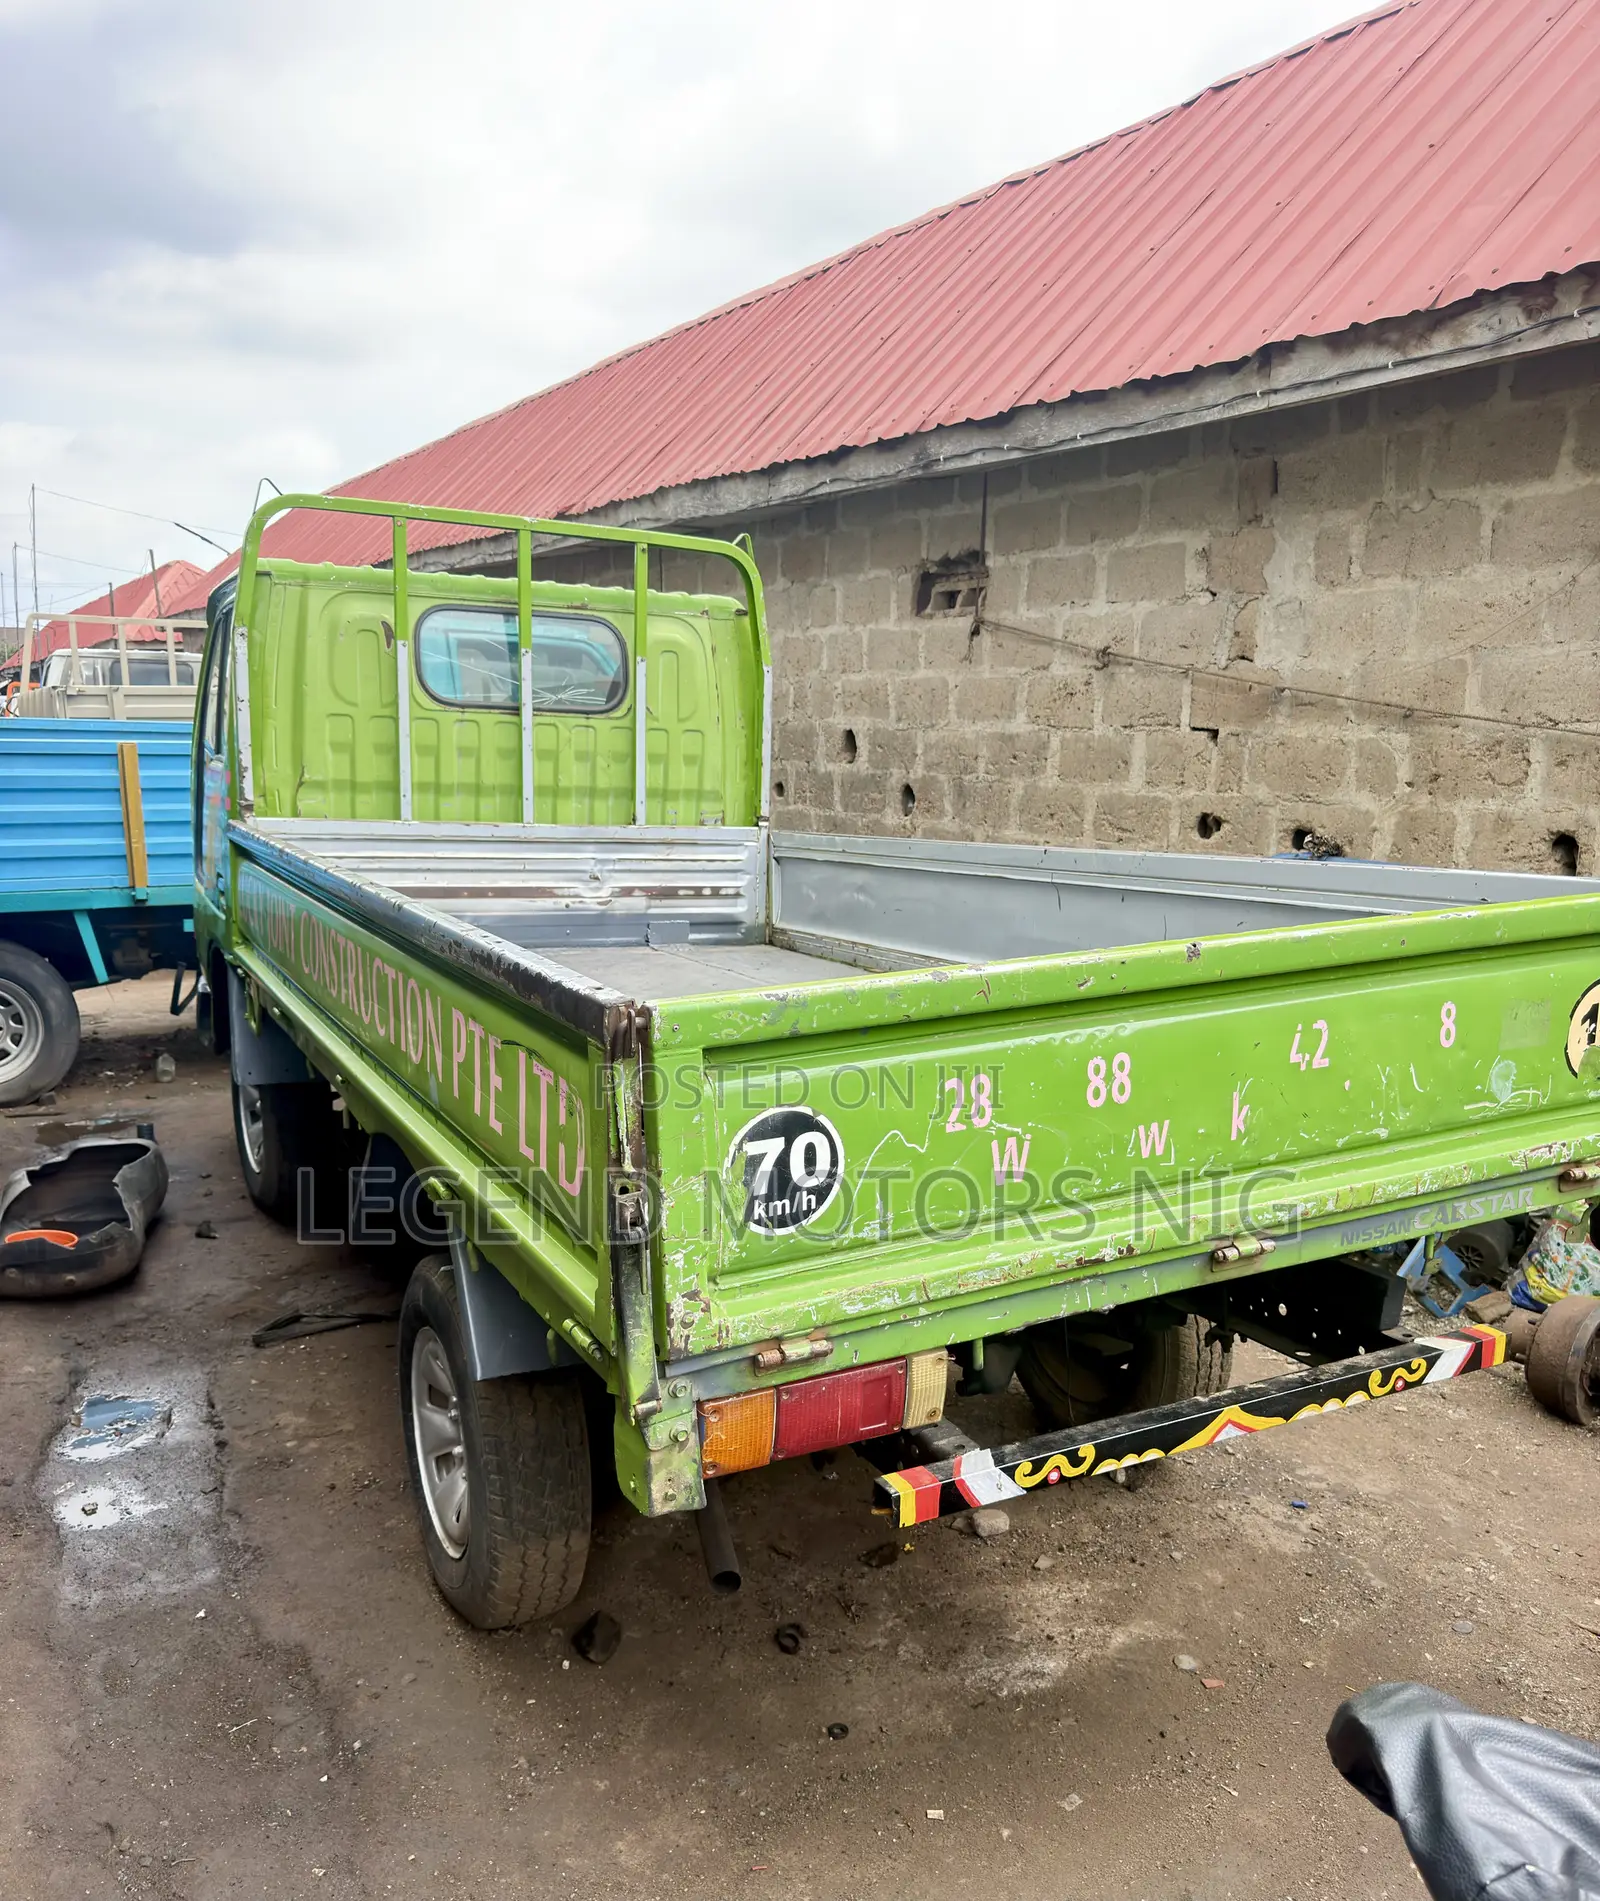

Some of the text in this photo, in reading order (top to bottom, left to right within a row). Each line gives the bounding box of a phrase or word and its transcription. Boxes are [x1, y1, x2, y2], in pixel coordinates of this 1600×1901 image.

[1289, 1019, 1330, 1071] 42
[1439, 1000, 1457, 1048] 8
[301, 910, 444, 1083] CONSTRUCTION
[451, 1007, 503, 1138] PTE
[518, 1048, 586, 1197] LTD
[1086, 1052, 1131, 1108] 88
[945, 1073, 992, 1133] 28
[744, 1131, 832, 1196] 70
[753, 1190, 817, 1221] km/h
[1340, 1218, 1413, 1247] NISSAN
